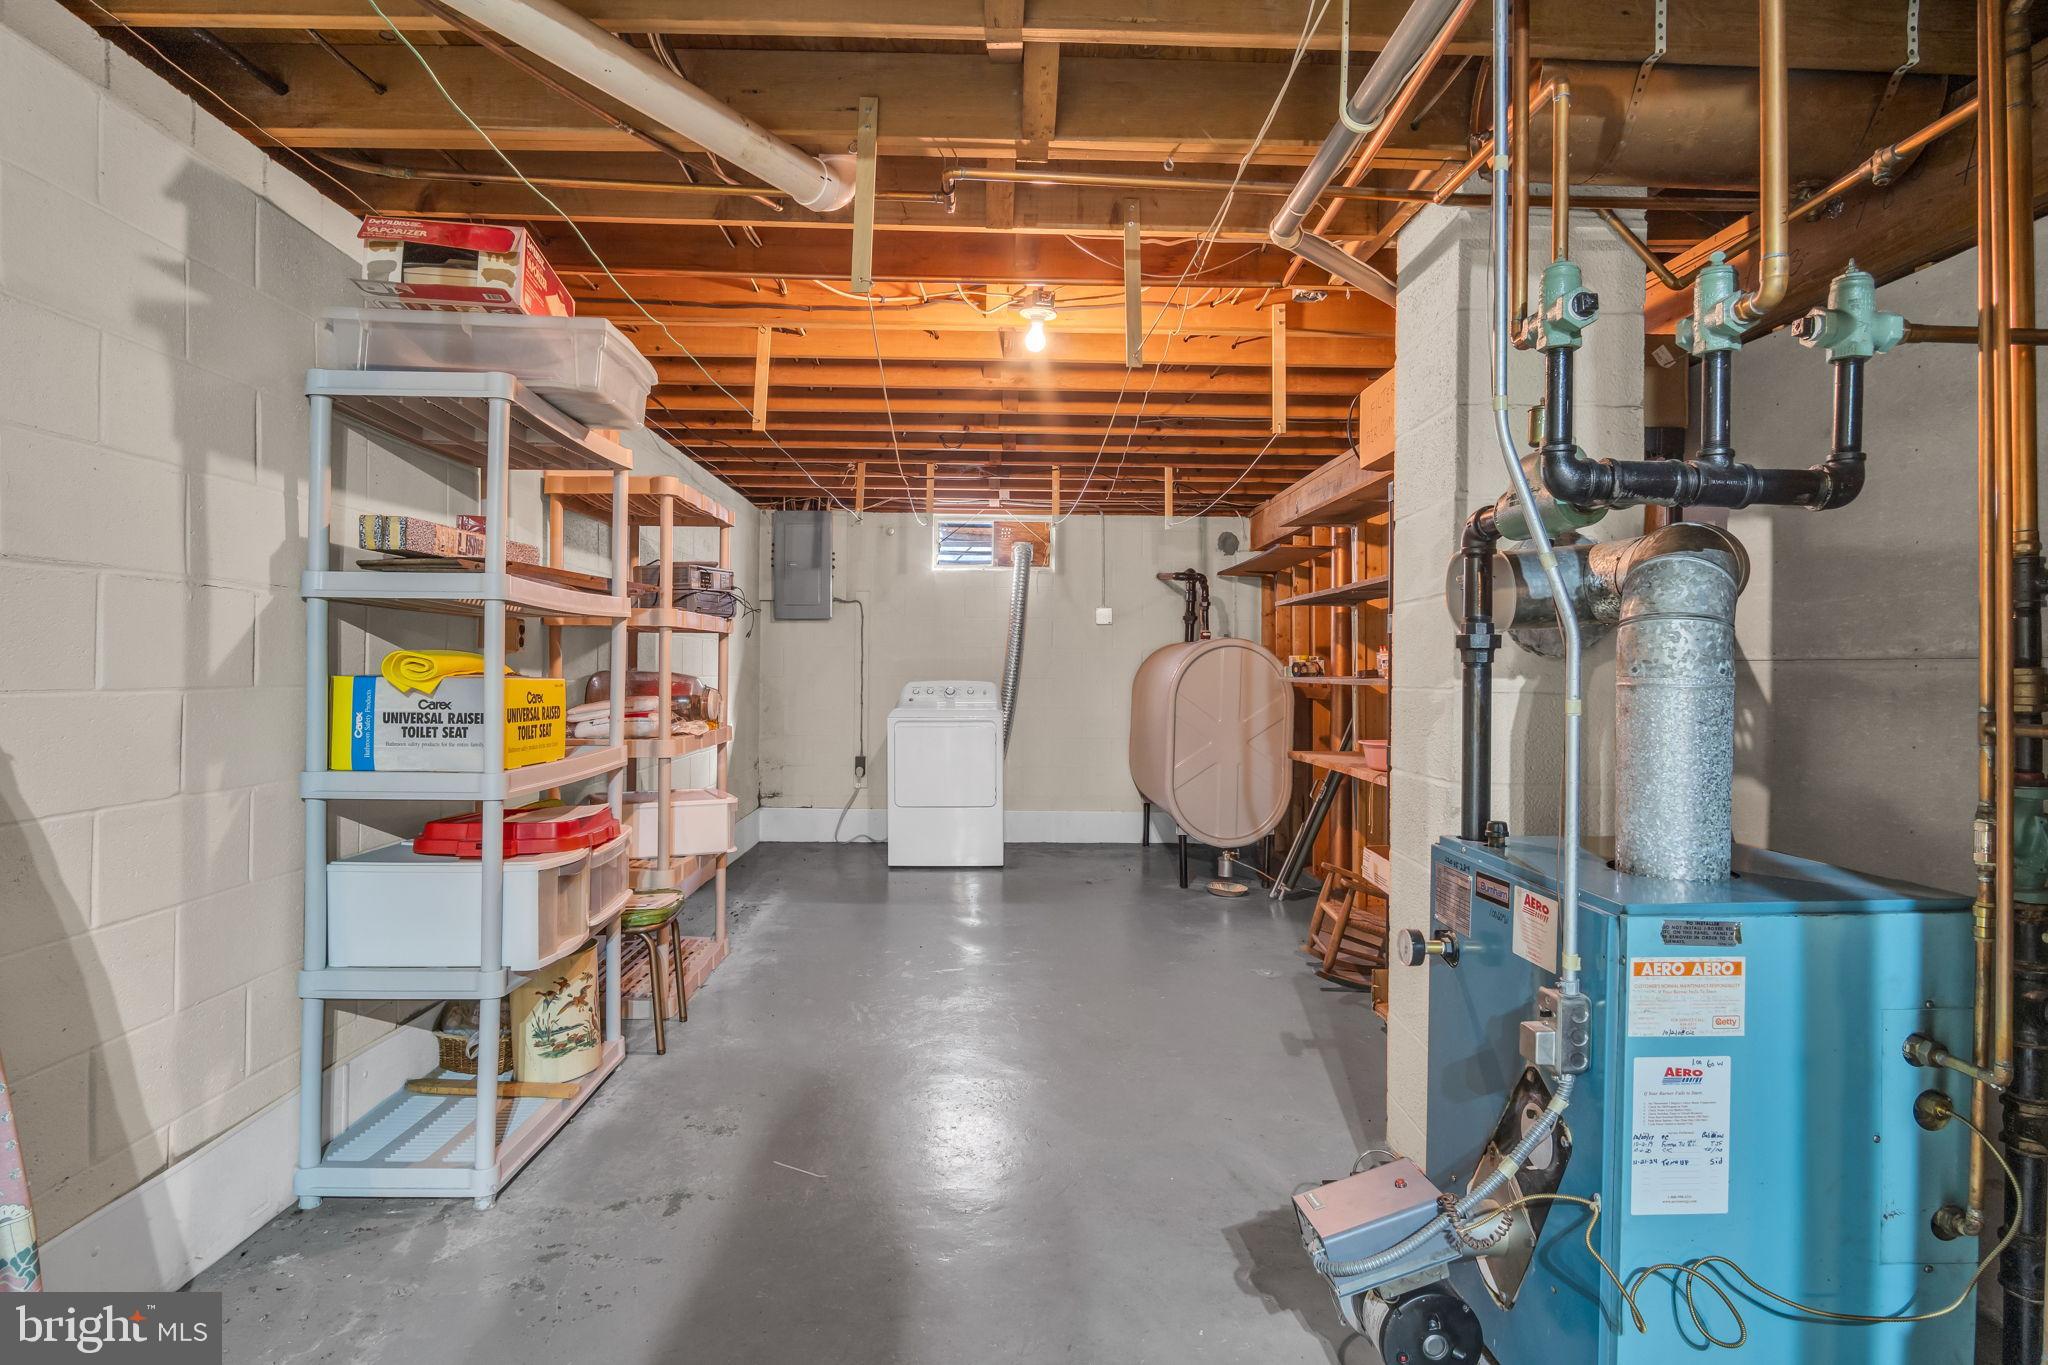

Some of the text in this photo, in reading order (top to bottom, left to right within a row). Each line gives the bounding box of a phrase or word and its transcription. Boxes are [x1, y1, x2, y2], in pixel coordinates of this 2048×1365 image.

[366, 225, 427, 237] VAPORIZER
[364, 689, 372, 713] Products
[418, 699, 452, 710] Carex
[527, 691, 544, 705] Carex
[382, 711, 444, 725] UNIVERSAL
[506, 705, 561, 724] UNIVERSAL RAISED
[354, 711, 363, 739] Carex
[364, 713, 373, 731] Safety
[401, 726, 469, 739] TOILET SEAT
[518, 723, 552, 741] TOILET SEAT
[1480, 881, 1508, 900] Burnham
[1524, 893, 1549, 915] AERO
[1641, 962, 1735, 976] AERO AERO
[1714, 1017, 1737, 1027] Getty
[1664, 1067, 1704, 1077] AERO
